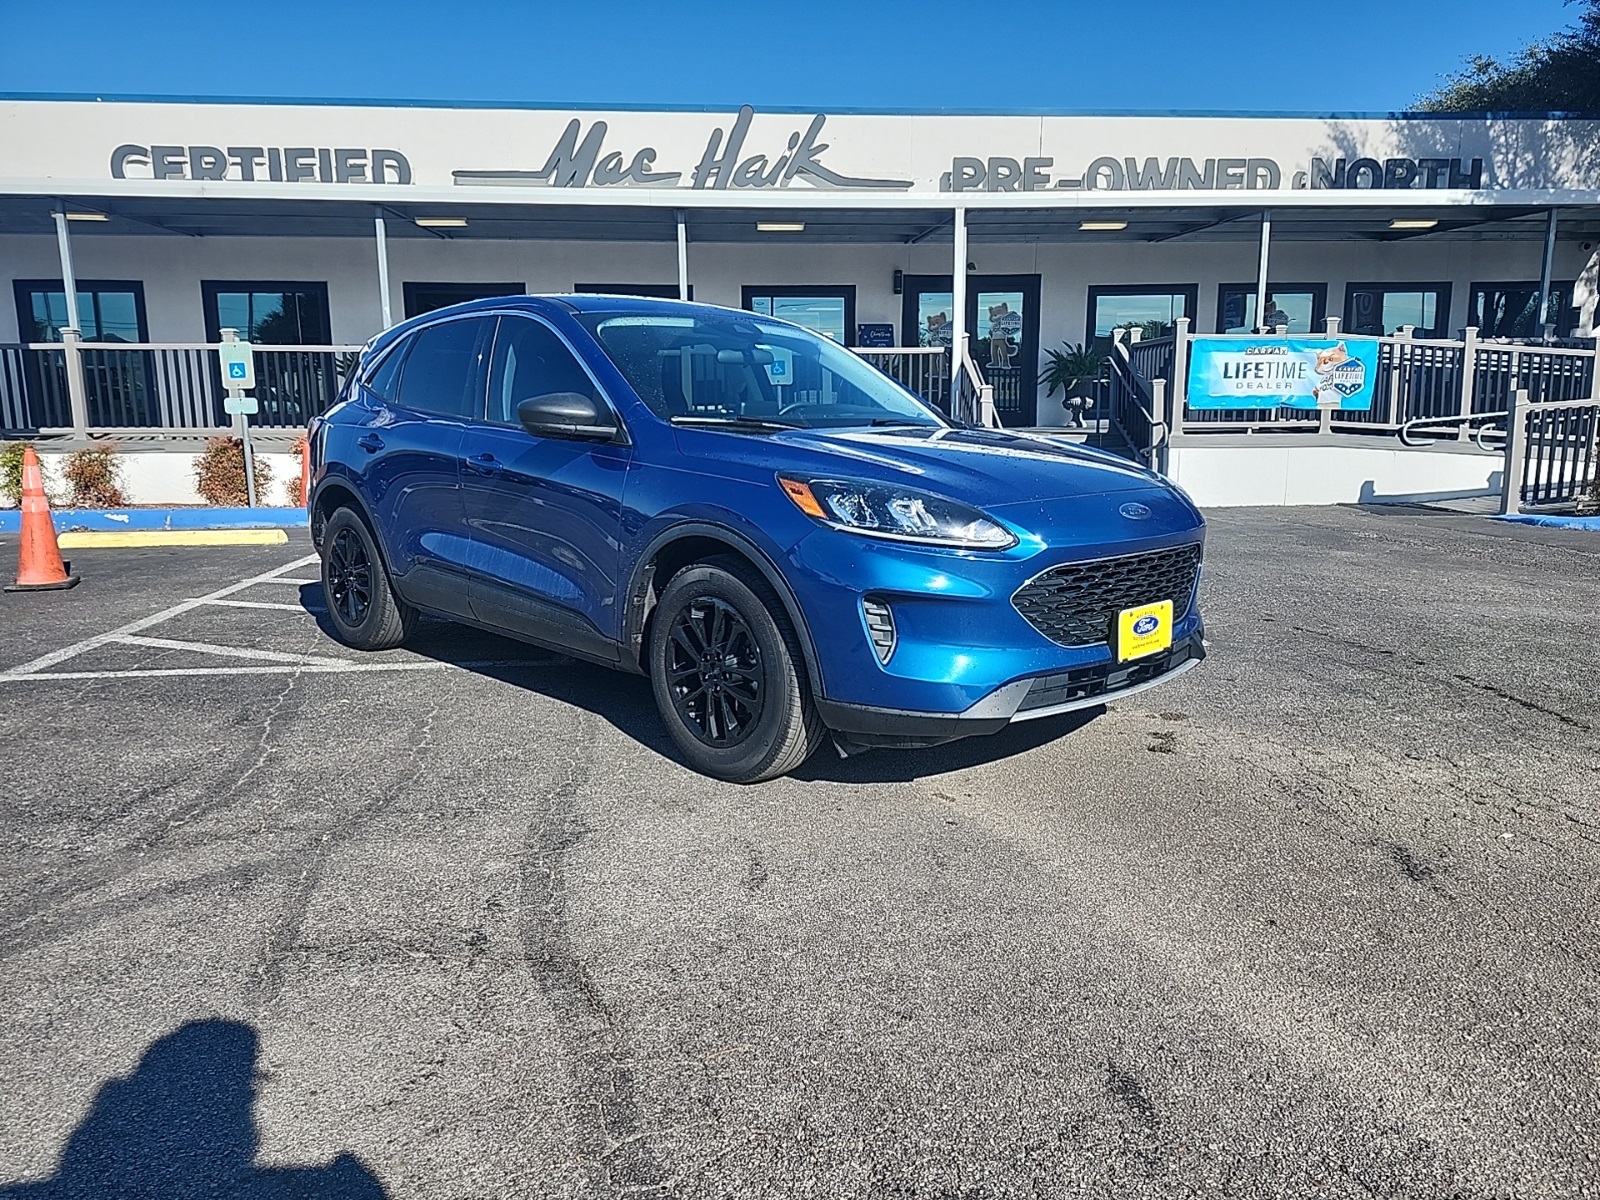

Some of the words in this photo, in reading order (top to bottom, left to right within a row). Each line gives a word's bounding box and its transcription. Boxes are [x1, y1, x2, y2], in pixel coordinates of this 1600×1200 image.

[525, 118, 682, 188] Mac
[692, 105, 850, 189] Haik
[110, 144, 412, 185] CERTIFIED
[952, 157, 1281, 192] PRE-OWNED
[1310, 157, 1482, 190] NORTH
[1245, 347, 1288, 355] CARFAX
[1223, 361, 1308, 380] LIFETIME
[1236, 381, 1293, 390] DEALER
[1136, 617, 1156, 633] Ford
